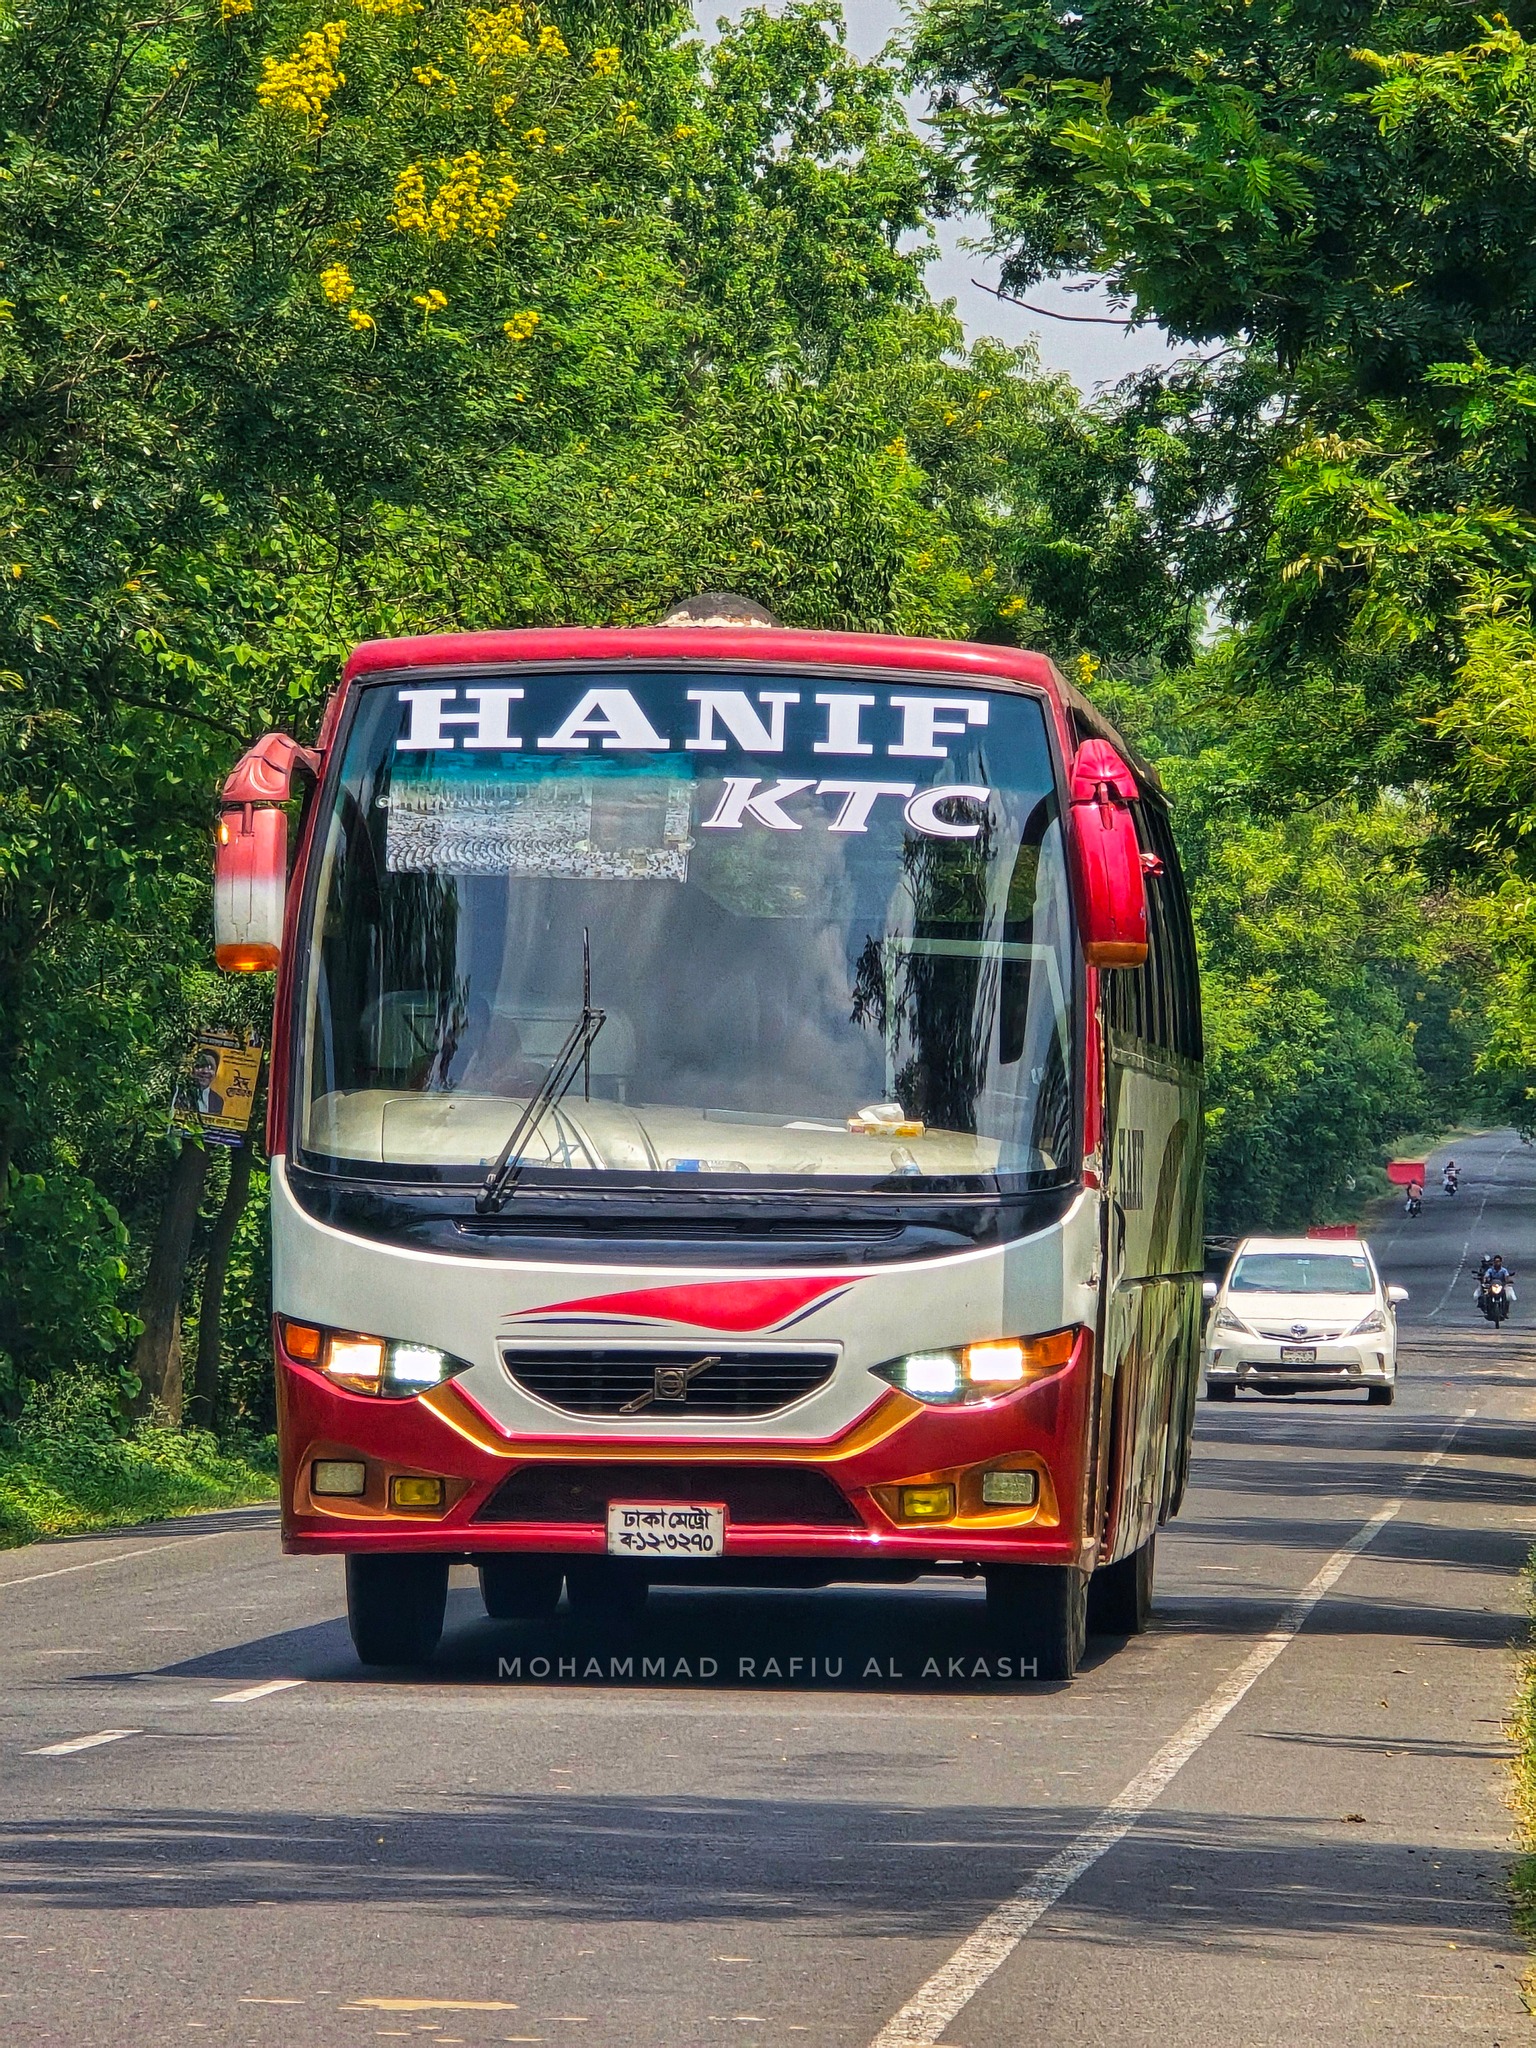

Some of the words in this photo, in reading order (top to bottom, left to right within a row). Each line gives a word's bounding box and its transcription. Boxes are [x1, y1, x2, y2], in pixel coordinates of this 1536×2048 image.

[396, 688, 989, 757] HANIF
[701, 778, 990, 838] KTC
[622, 1508, 668, 1528] ঢাকা
[669, 1506, 713, 1530] মেট্রো
